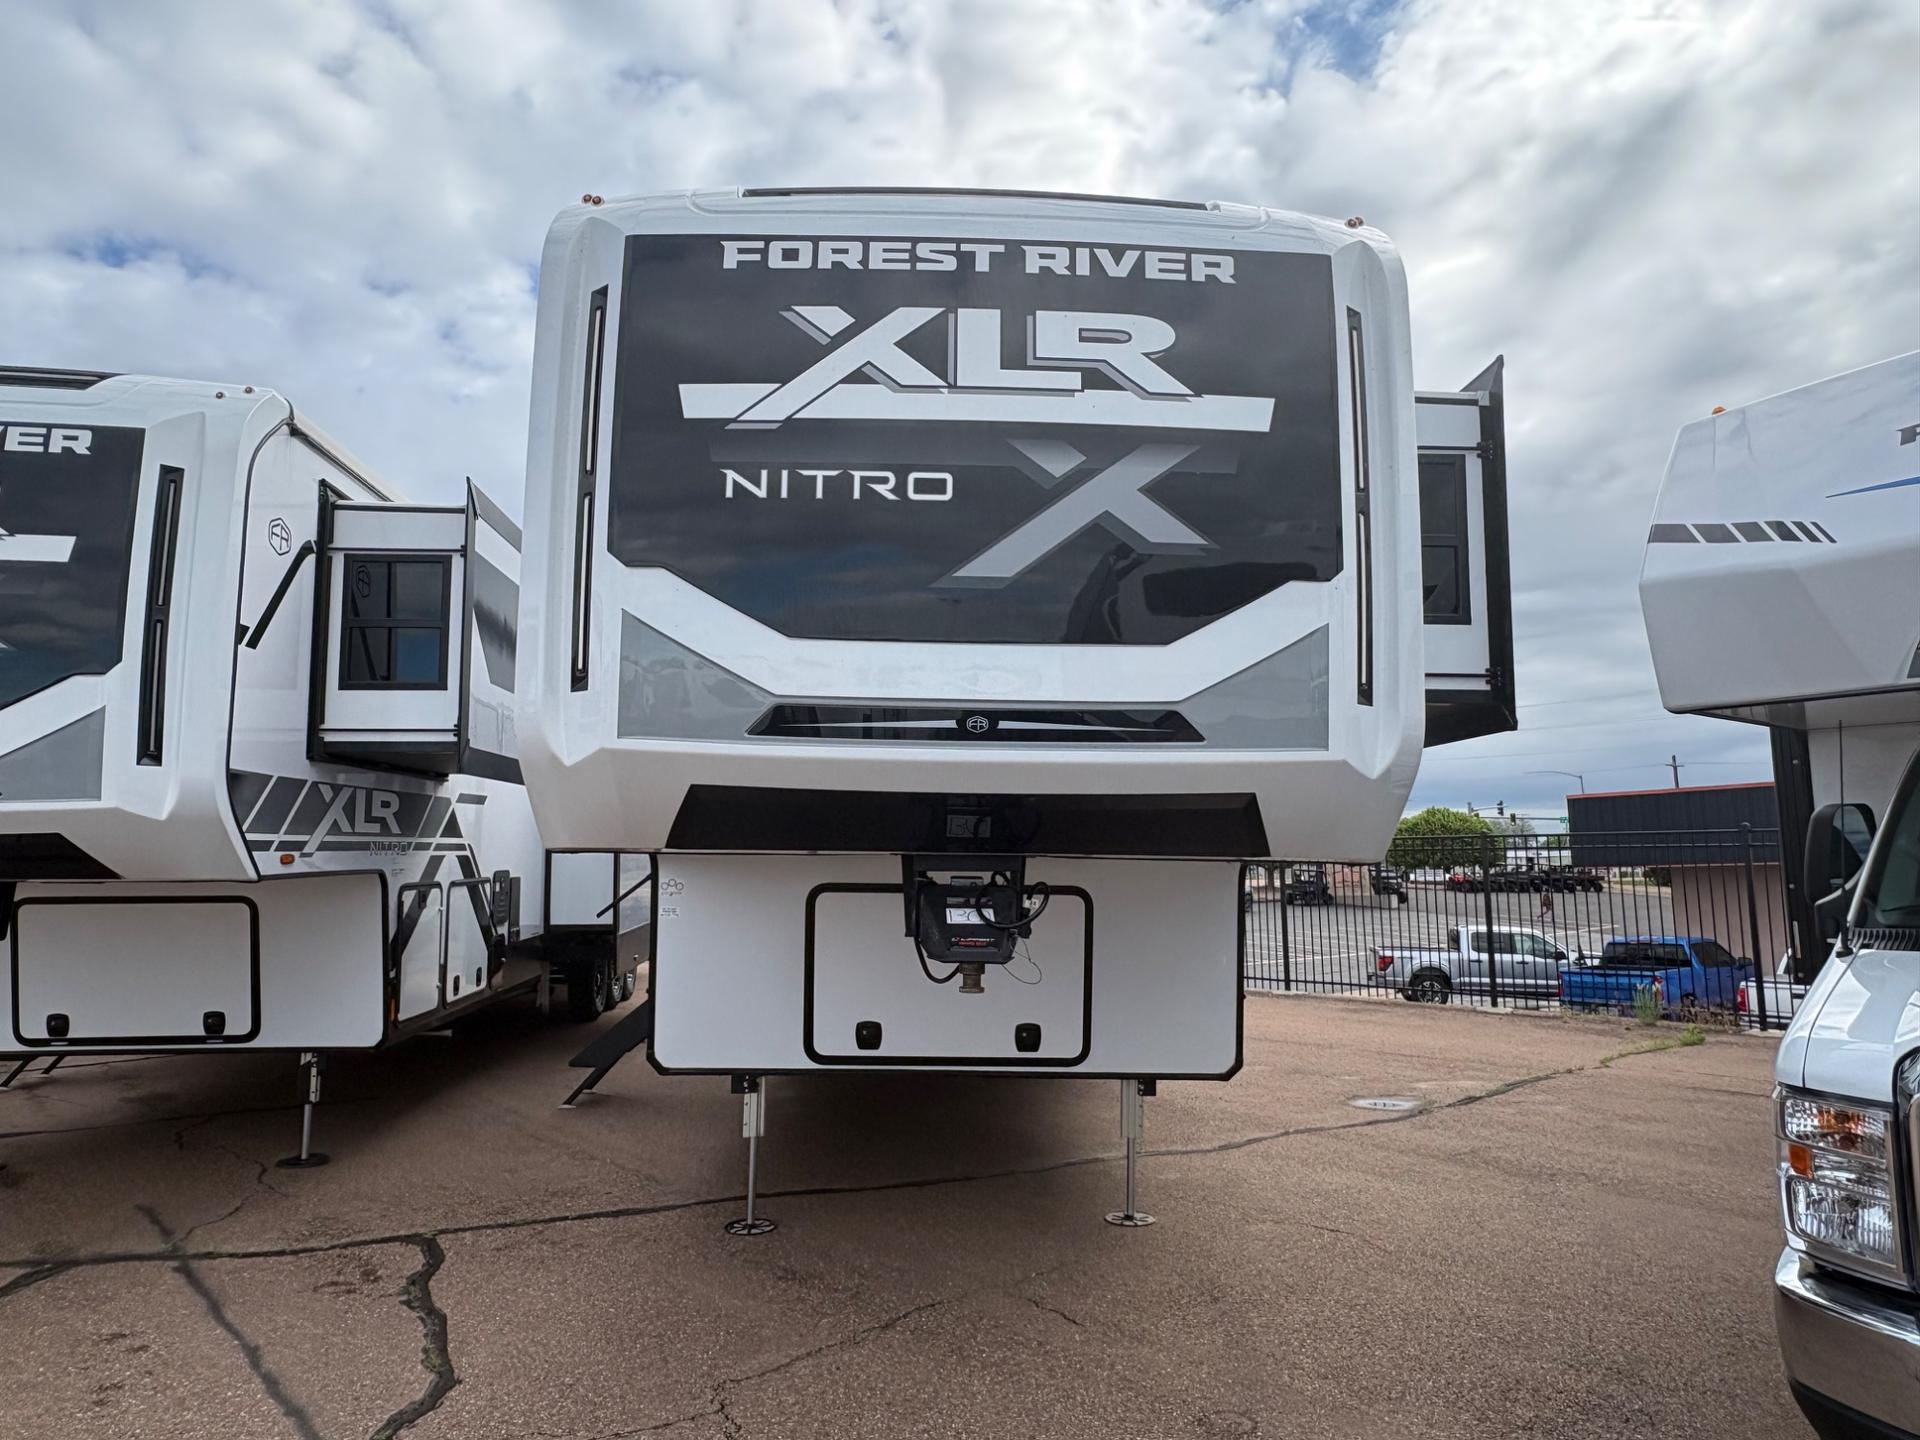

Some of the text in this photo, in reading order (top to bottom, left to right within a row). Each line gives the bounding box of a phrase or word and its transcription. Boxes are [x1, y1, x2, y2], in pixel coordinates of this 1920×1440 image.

[720, 241, 1237, 284] FOREST RIVER
[732, 305, 1199, 425] XLR
[0, 426, 92, 455] ER
[720, 468, 954, 501] NITRO
[301, 783, 402, 856] XLR
[369, 841, 408, 857] NITRO
